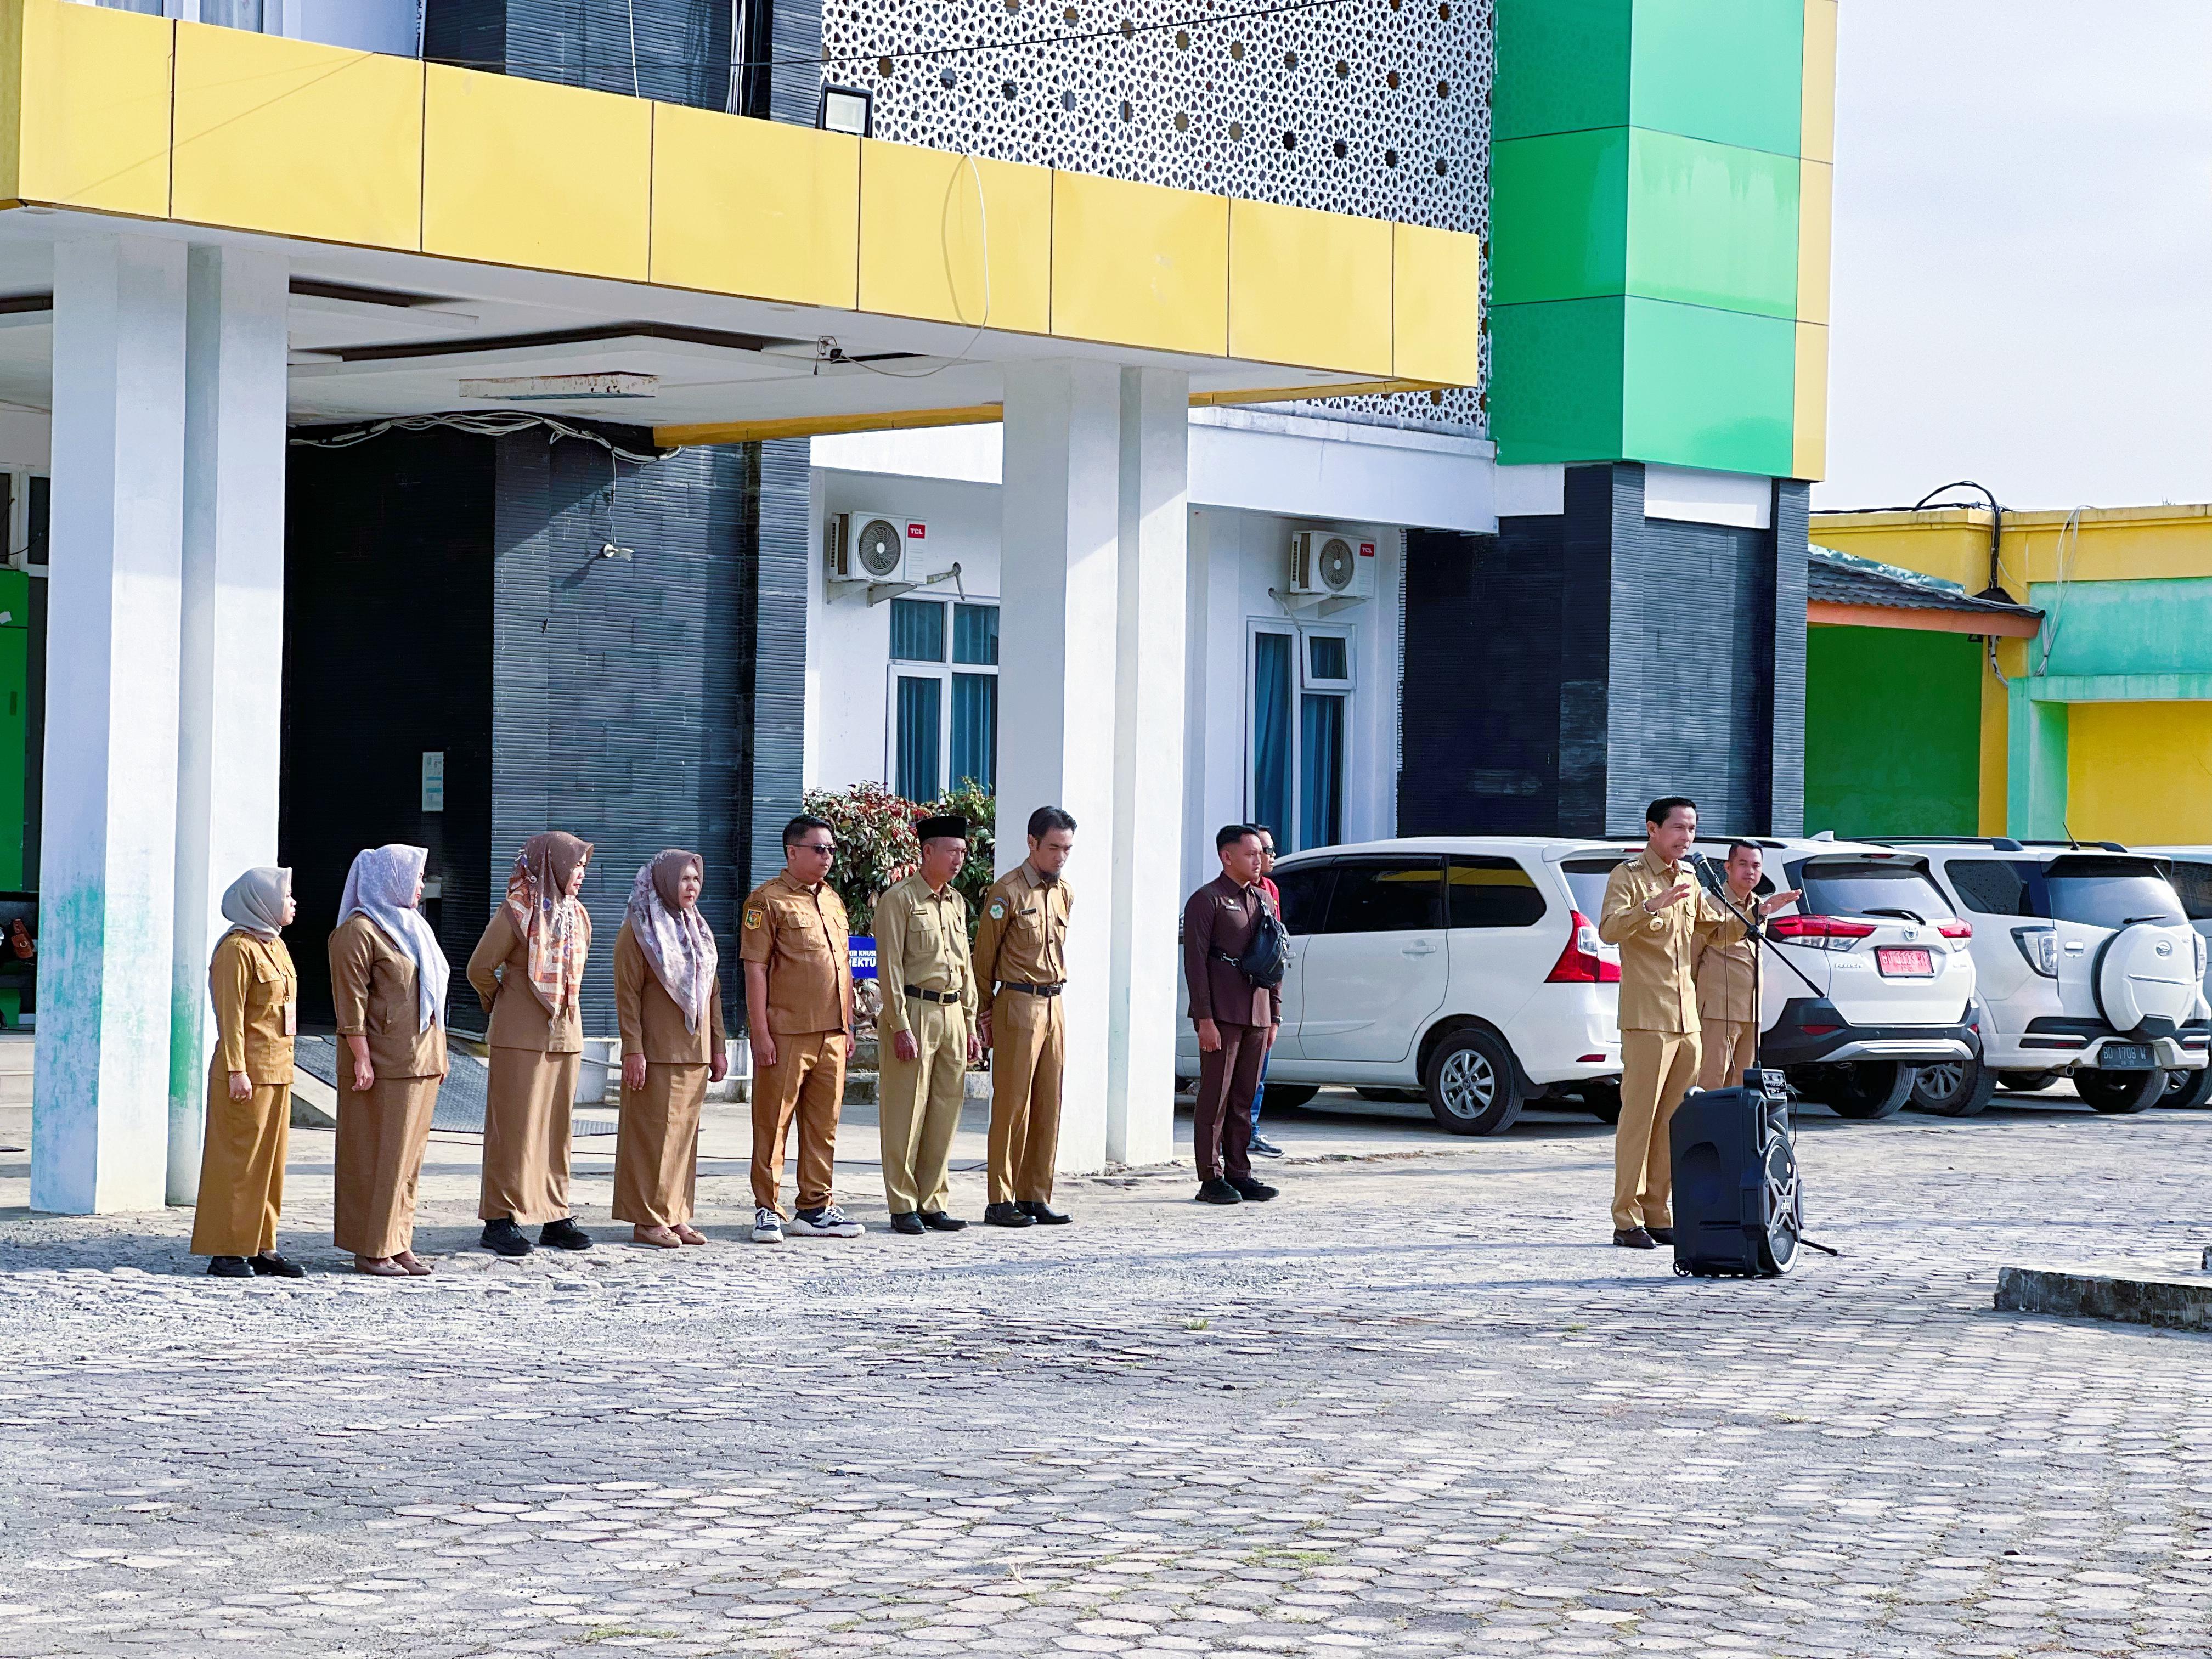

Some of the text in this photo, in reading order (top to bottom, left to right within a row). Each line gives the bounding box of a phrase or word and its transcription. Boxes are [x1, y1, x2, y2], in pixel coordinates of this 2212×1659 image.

[2103, 1046, 2146, 1059] BD 1708 W
